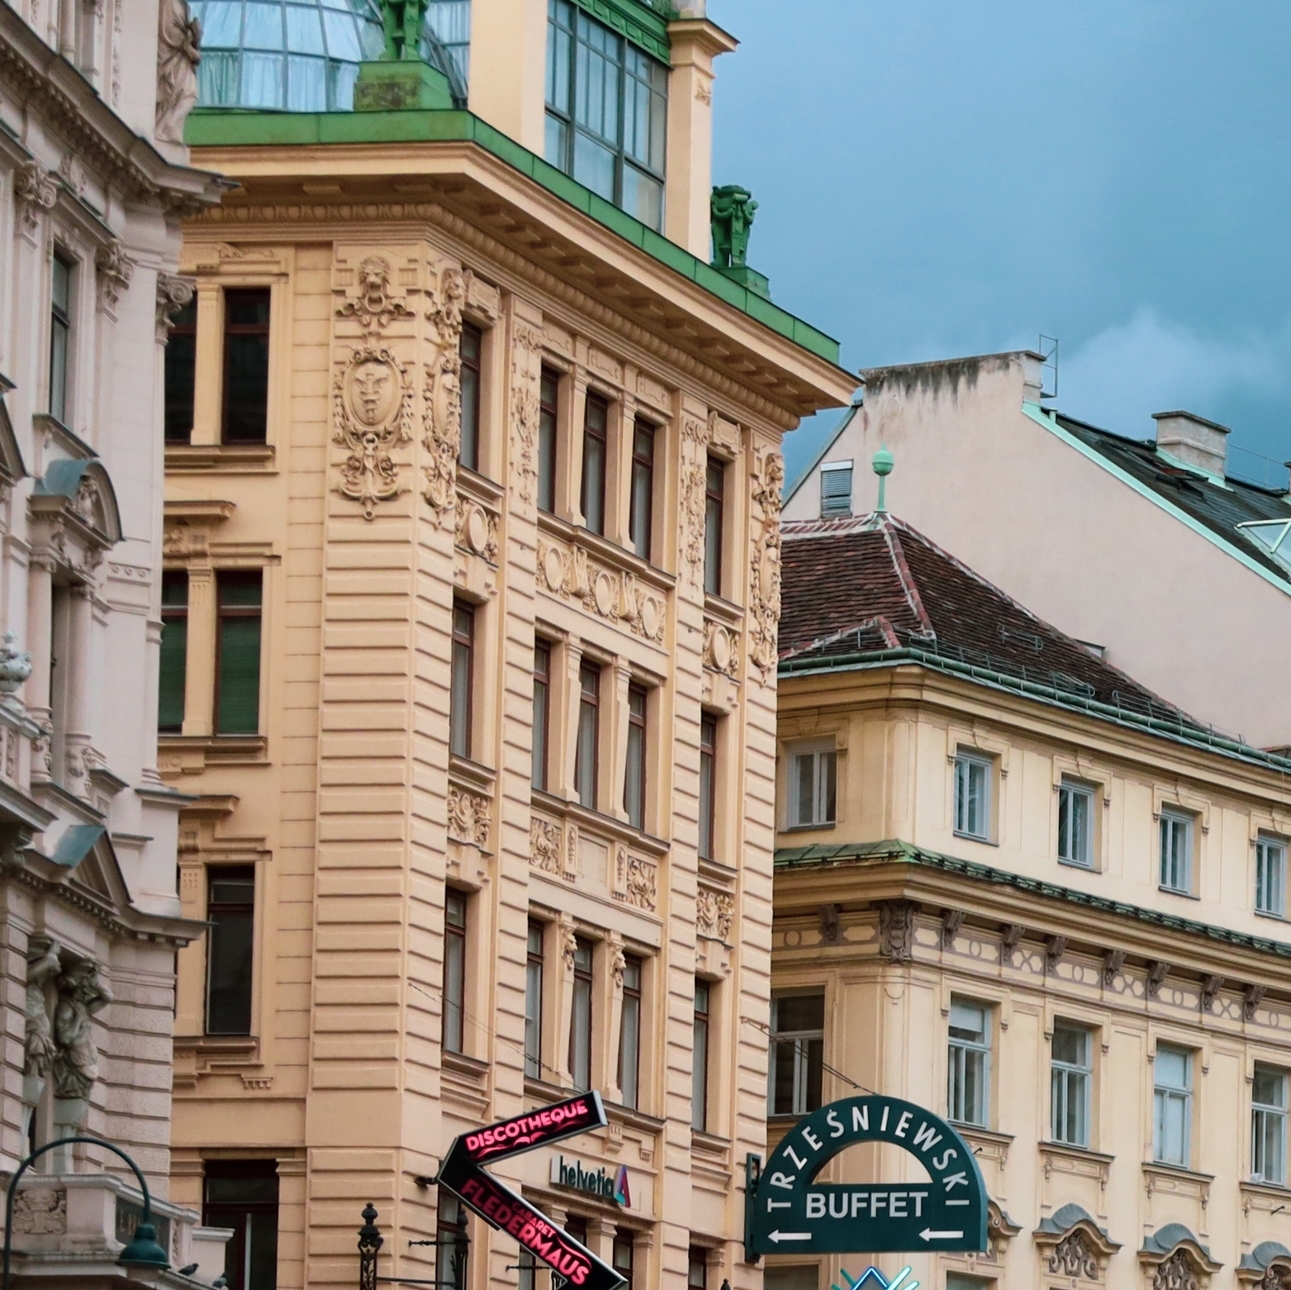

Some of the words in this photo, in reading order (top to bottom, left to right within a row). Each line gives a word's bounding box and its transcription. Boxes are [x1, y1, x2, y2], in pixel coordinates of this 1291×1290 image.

[465, 1100, 588, 1151] DISCOTHEQUE
[558, 1155, 614, 1198] helvetia
[767, 1104, 970, 1213] TRZEŚNIEWSKI
[511, 1201, 556, 1239] CABARET
[806, 1191, 928, 1219] BUFFET
[460, 1178, 590, 1285] FLEDERMAUS
